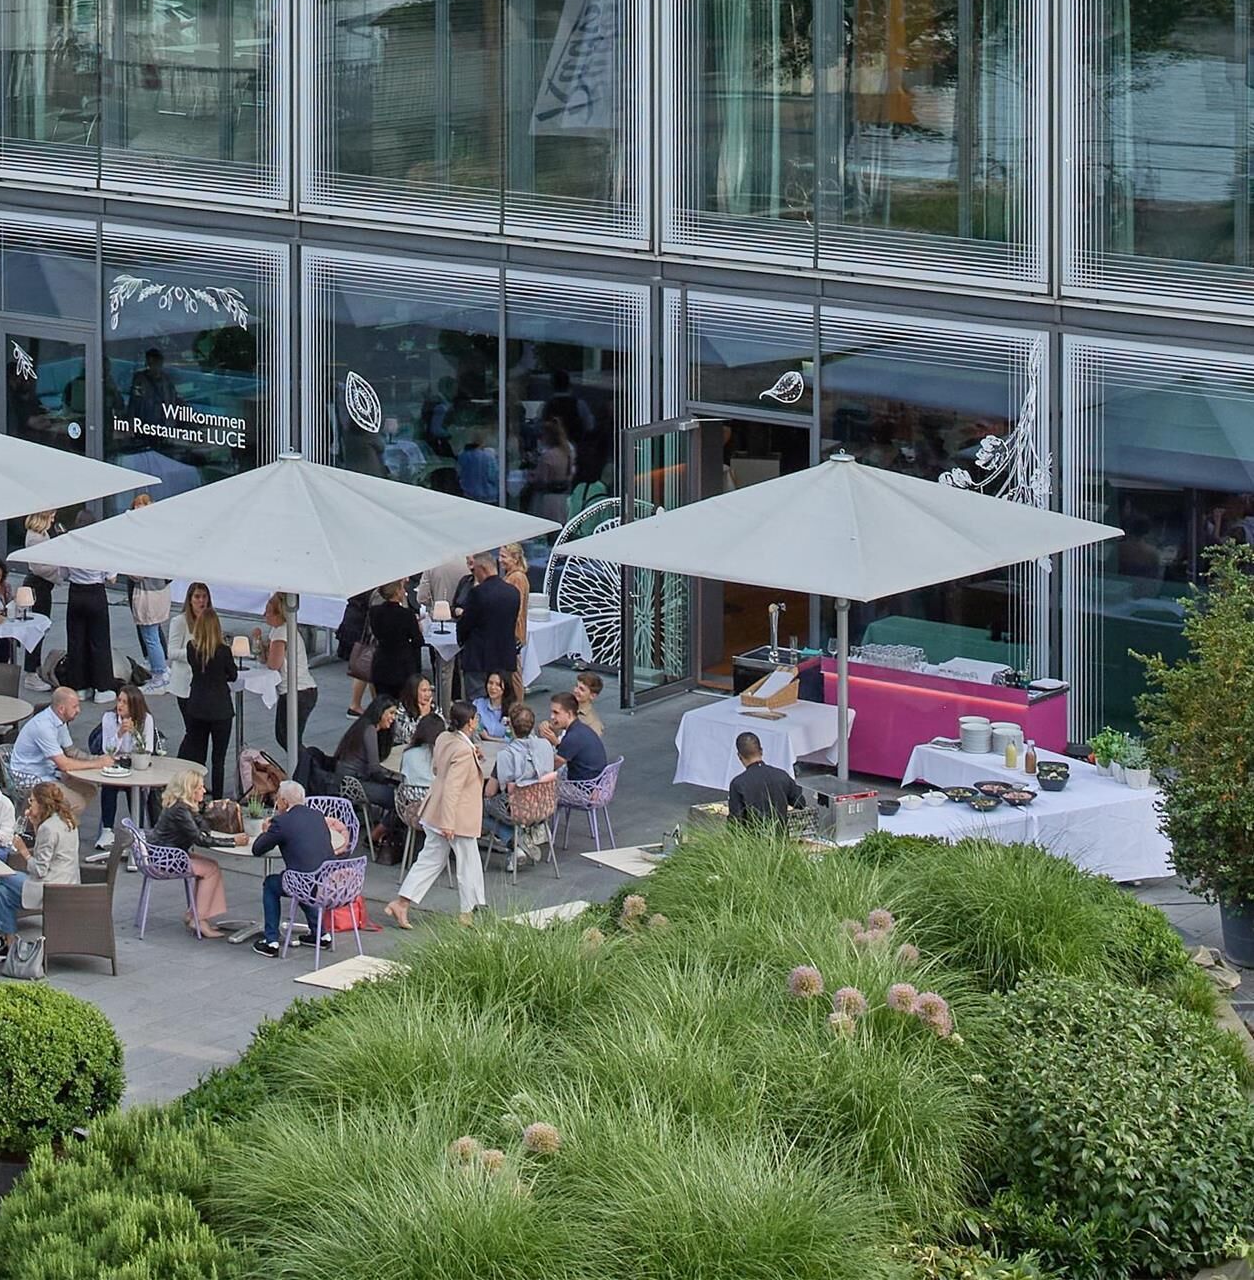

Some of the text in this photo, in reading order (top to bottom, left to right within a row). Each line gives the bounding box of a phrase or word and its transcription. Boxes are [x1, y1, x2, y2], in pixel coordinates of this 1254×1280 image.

[162, 402, 246, 430] Willkommen
[113, 415, 246, 449] im Restaurant LUCE
